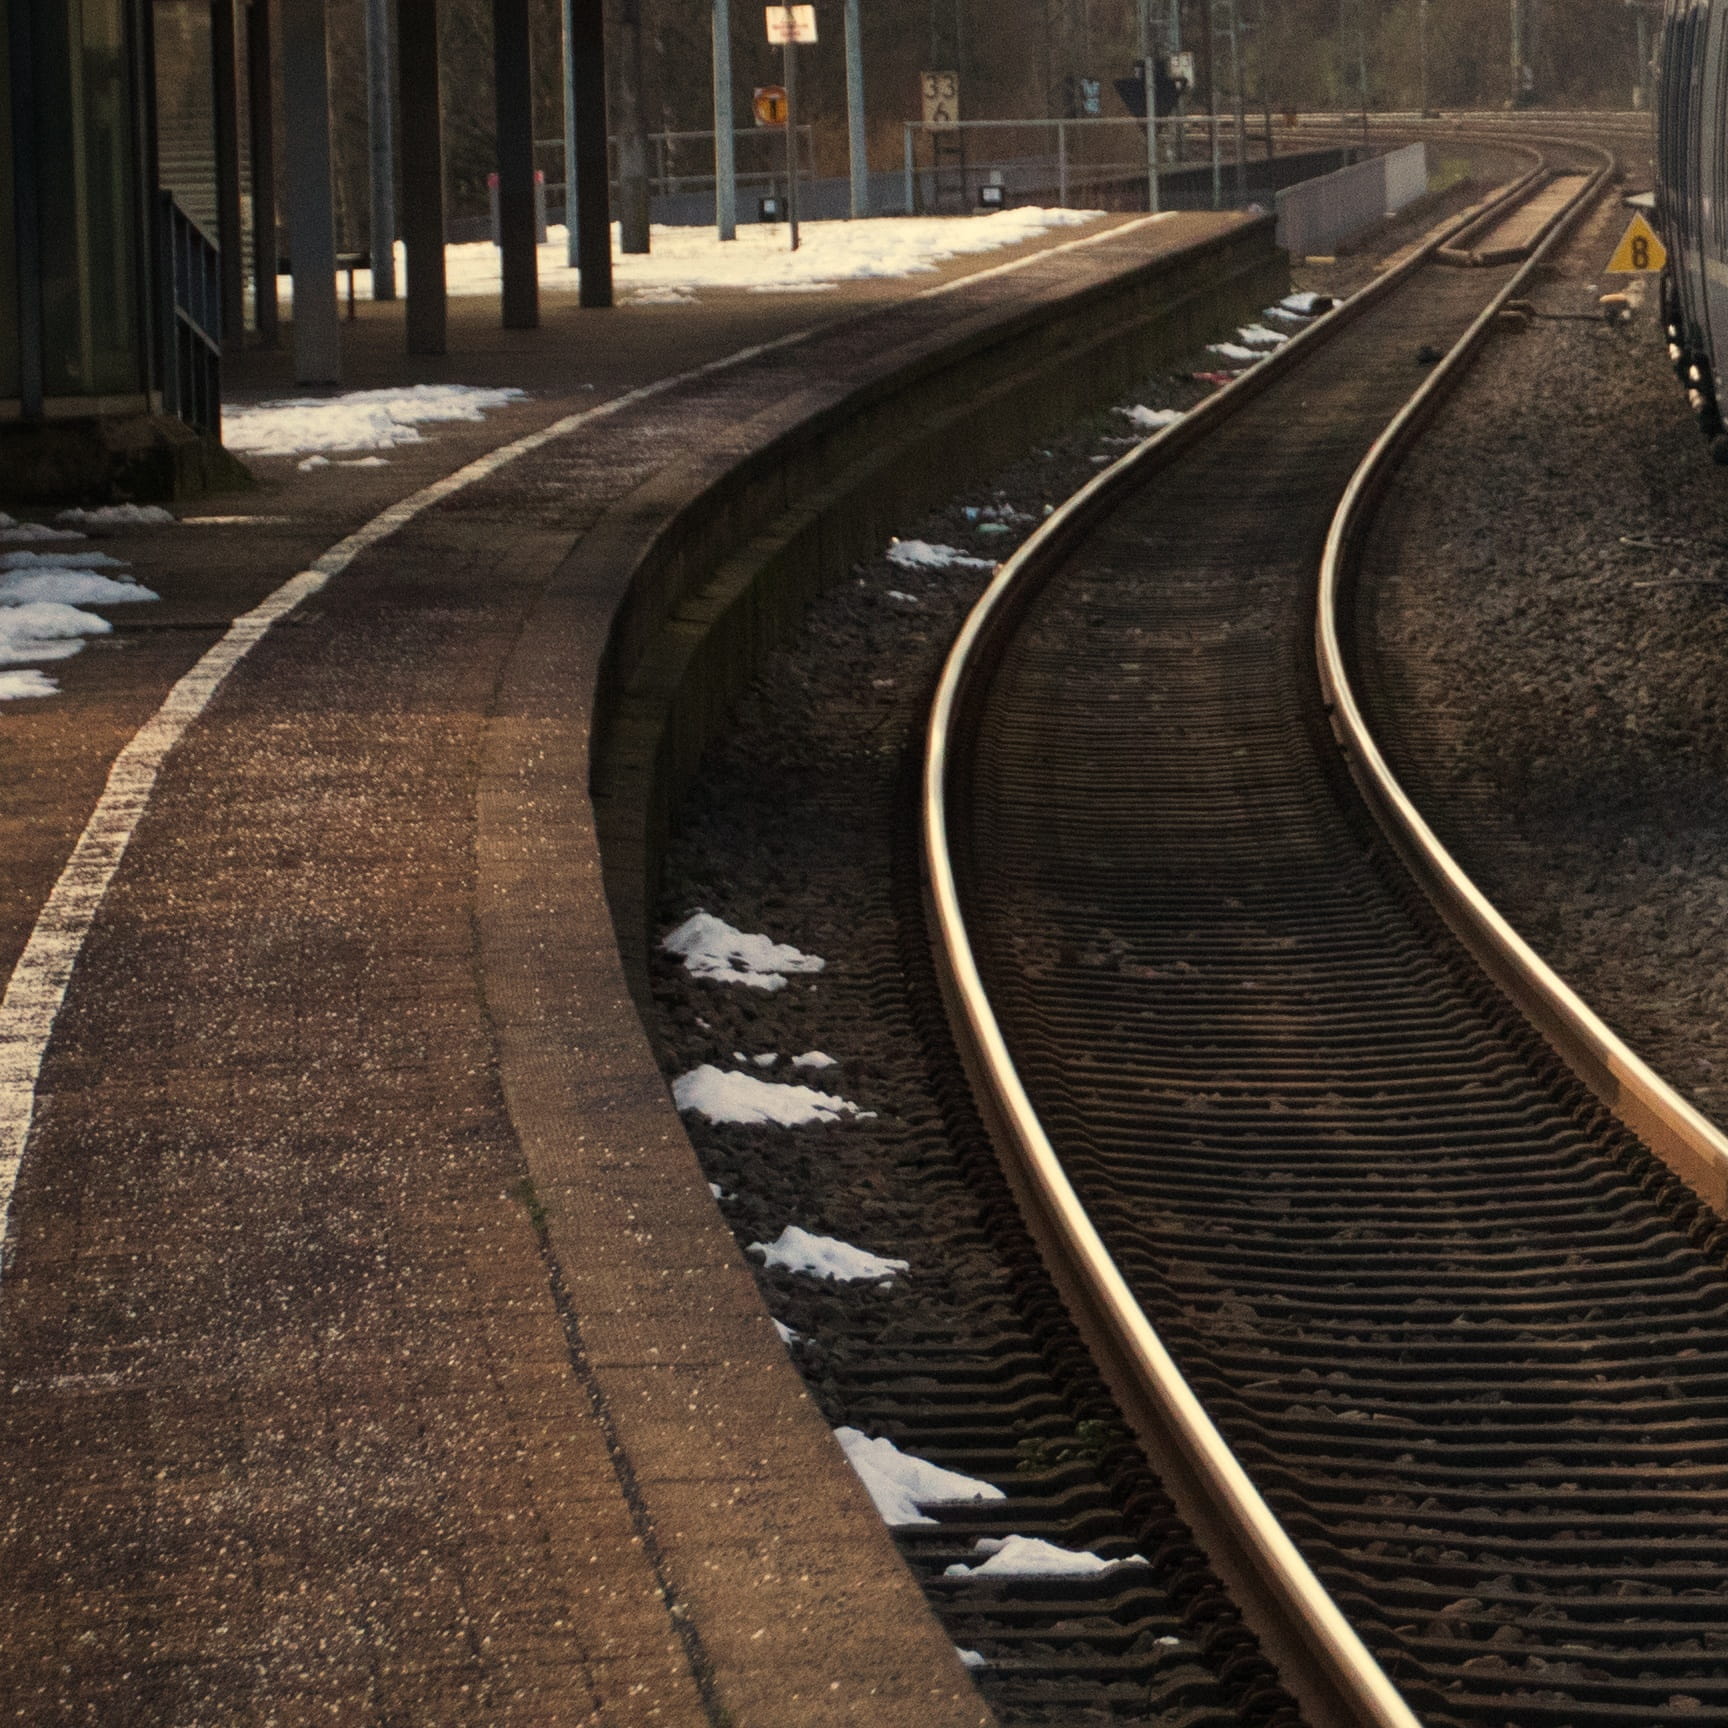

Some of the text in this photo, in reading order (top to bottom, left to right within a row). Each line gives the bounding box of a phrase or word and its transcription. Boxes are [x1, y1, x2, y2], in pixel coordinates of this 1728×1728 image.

[925, 75, 955, 97] 33
[932, 100, 950, 122] 6
[1633, 236, 1649, 269] 8
